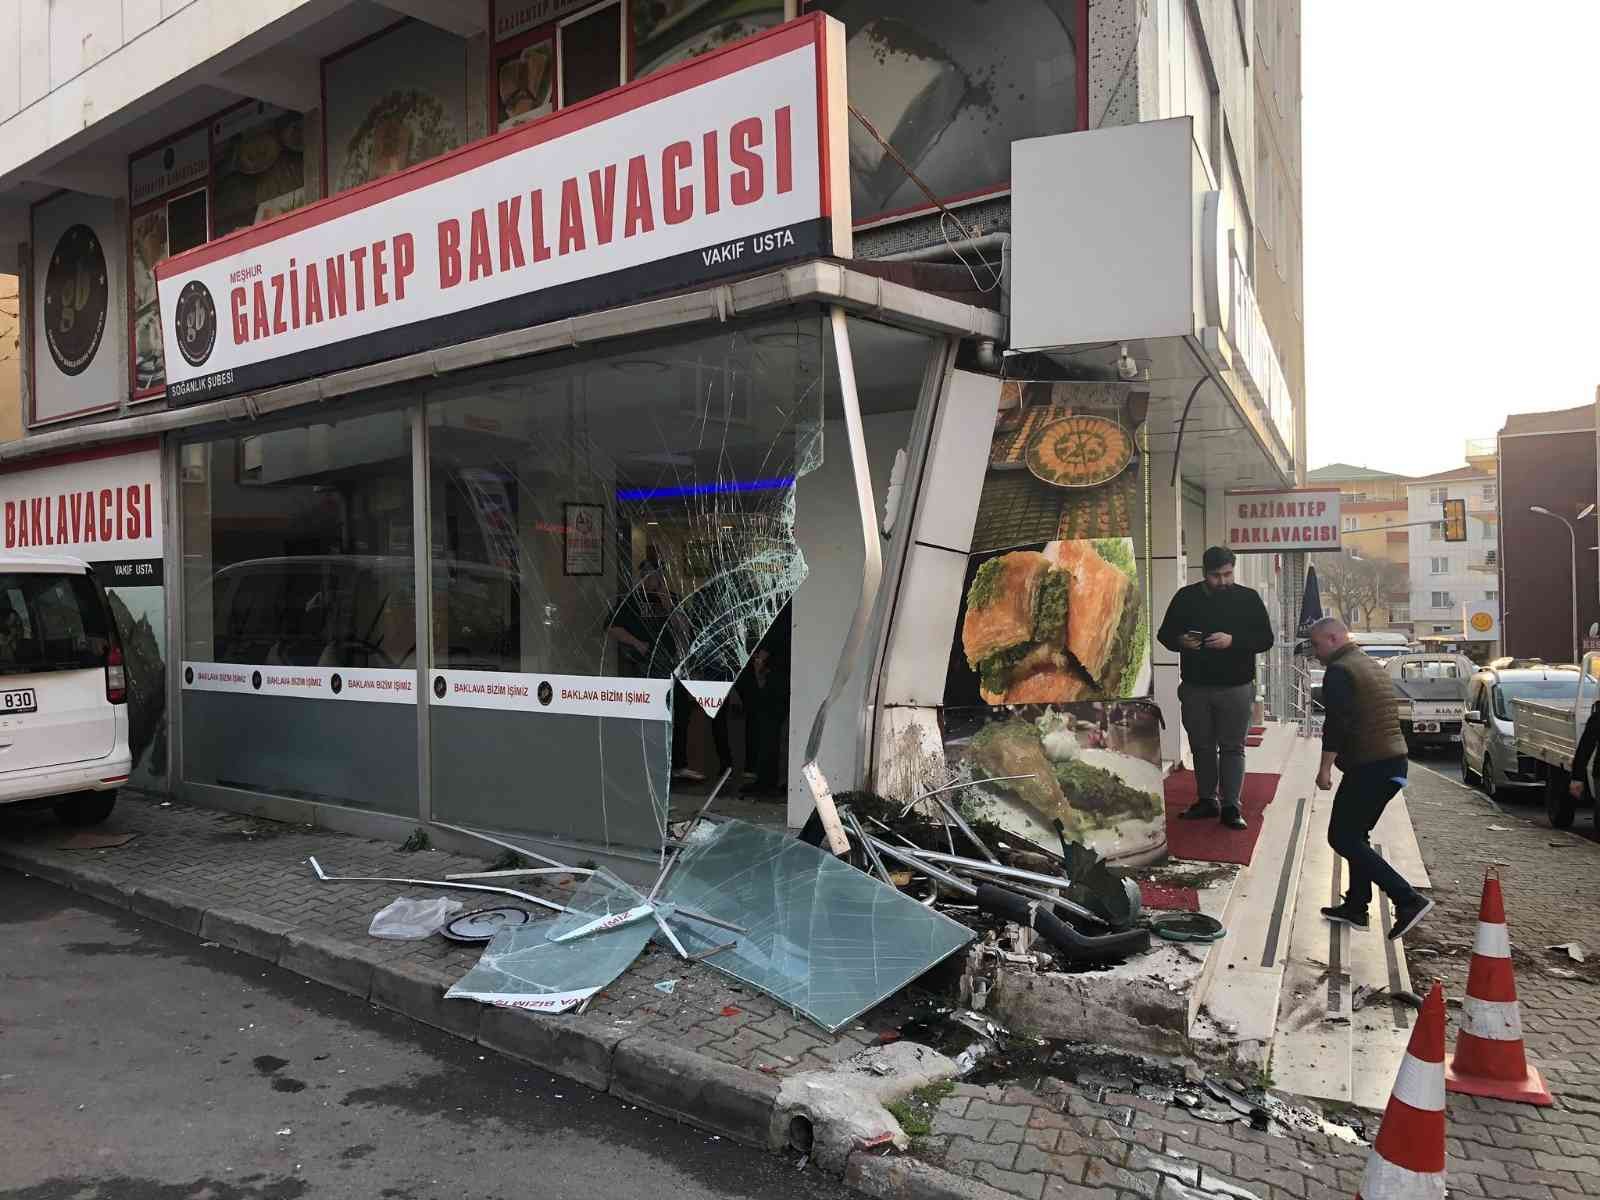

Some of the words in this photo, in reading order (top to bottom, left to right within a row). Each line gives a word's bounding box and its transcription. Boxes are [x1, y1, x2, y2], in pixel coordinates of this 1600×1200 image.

[231, 232, 415, 345] GAZİANTEP
[437, 105, 793, 289] BAKLAVACISI
[702, 241, 745, 266] VAKIF
[753, 230, 795, 253] USTA
[230, 264, 263, 284] MEŞHUR
[171, 379, 207, 397] SOĞANLIK
[208, 368, 234, 391] ŞUBESİ
[5, 483, 152, 549] BAKLAVACISI
[1238, 500, 1326, 519] GAZİANTEP
[1231, 526, 1337, 544] BAKLAVACISI
[135, 563, 153, 575] USTA
[348, 679, 375, 689] BAKLAVA
[454, 683, 485, 693] BAKLAVA
[487, 683, 506, 695] BİZİM
[507, 684, 529, 698] İŞİMİZ
[5, 692, 31, 708] 830
[561, 689, 599, 701] BAKLAVA
[600, 689, 623, 703] BİZİM
[625, 690, 651, 705] İŞİMİZ
